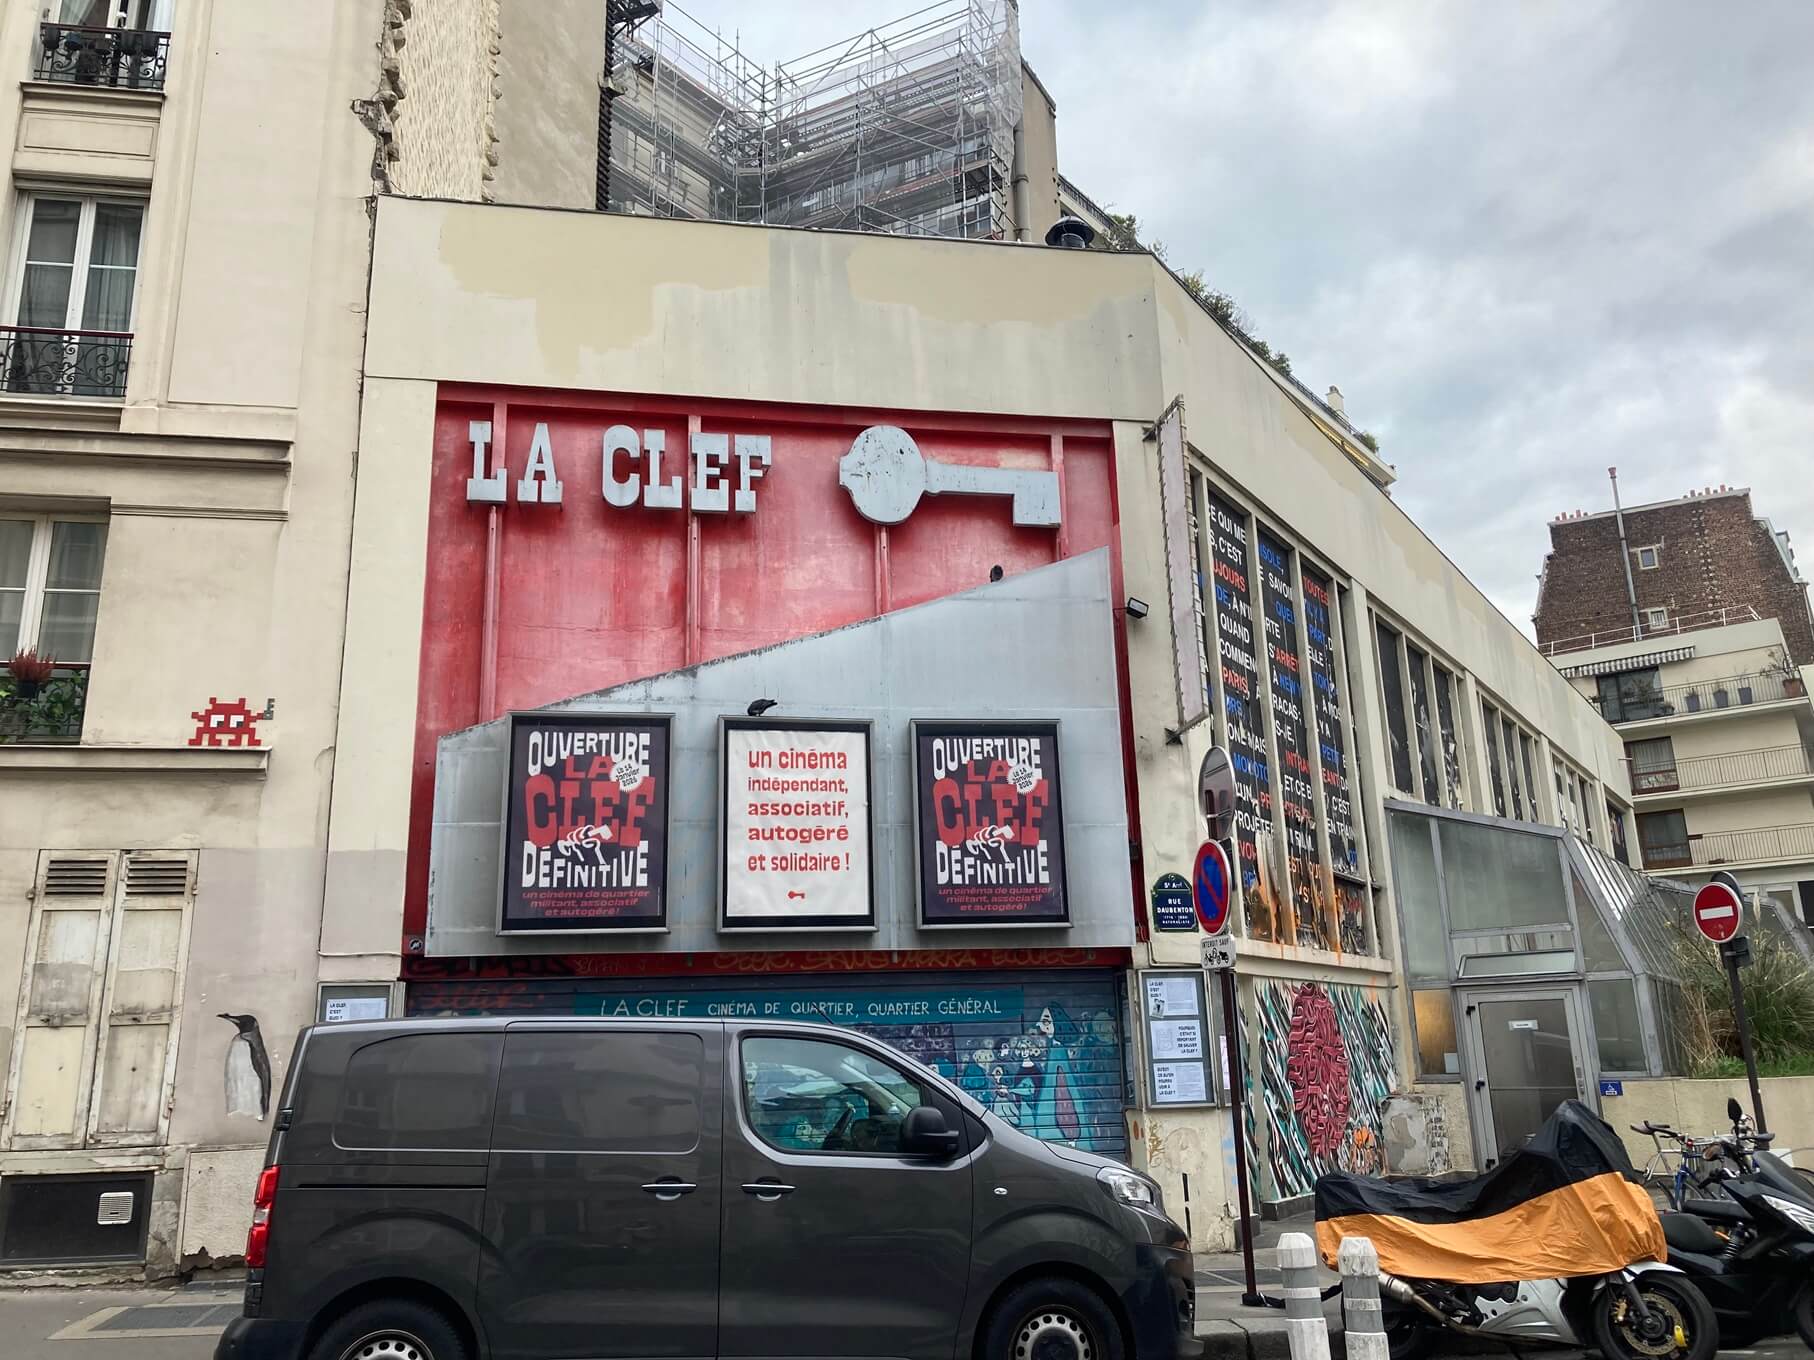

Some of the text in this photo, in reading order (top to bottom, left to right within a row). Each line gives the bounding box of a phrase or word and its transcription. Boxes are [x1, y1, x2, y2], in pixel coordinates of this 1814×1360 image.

[466, 420, 772, 514] LA CLEF
[1217, 511, 1233, 534] QUI
[1233, 523, 1246, 545] ME
[1218, 537, 1242, 565] C'EST
[1219, 612, 1250, 644] QUAND
[528, 731, 650, 777] OUVERTURE
[748, 748, 847, 770] un cinéma
[933, 738, 1043, 781] OUVERTURE
[566, 756, 613, 779] LA
[967, 760, 1010, 782] LA
[748, 776, 848, 794] indépendant,
[525, 774, 656, 848] CLEF
[748, 801, 849, 819] associatif,
[932, 777, 1049, 846] CLEF
[748, 825, 849, 844] autogéré
[522, 840, 649, 888] DÉFINITIVE
[747, 852, 850, 872] et solidaire !
[935, 839, 1050, 885] DÉFINITIVE
[522, 889, 650, 899] un cinéma de quartier
[938, 886, 1053, 896] un cinéma de quartier
[544, 908, 558, 916] et
[600, 998, 1002, 1018] LA CLEF CINÉMA DE QUARTIER, QUARTIER GÉNÉRAL
